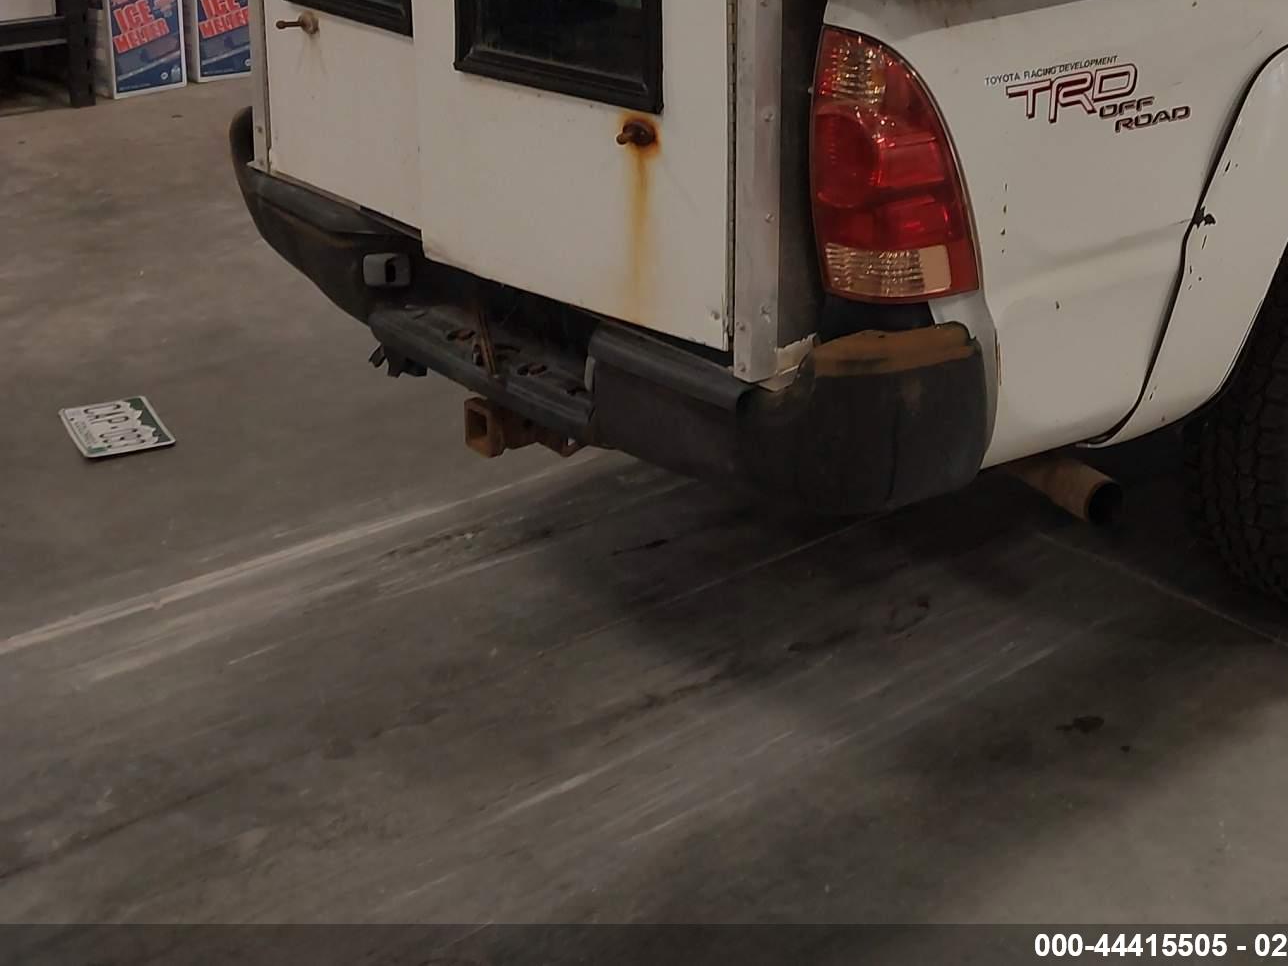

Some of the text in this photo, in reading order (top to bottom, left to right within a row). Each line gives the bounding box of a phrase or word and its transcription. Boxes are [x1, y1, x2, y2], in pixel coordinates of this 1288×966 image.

[985, 55, 1118, 86] TOYOTA RACING DEVELOPMENT
[1006, 63, 1138, 124] TRD
[1099, 96, 1155, 119] OFF
[1114, 105, 1191, 133] ROAD
